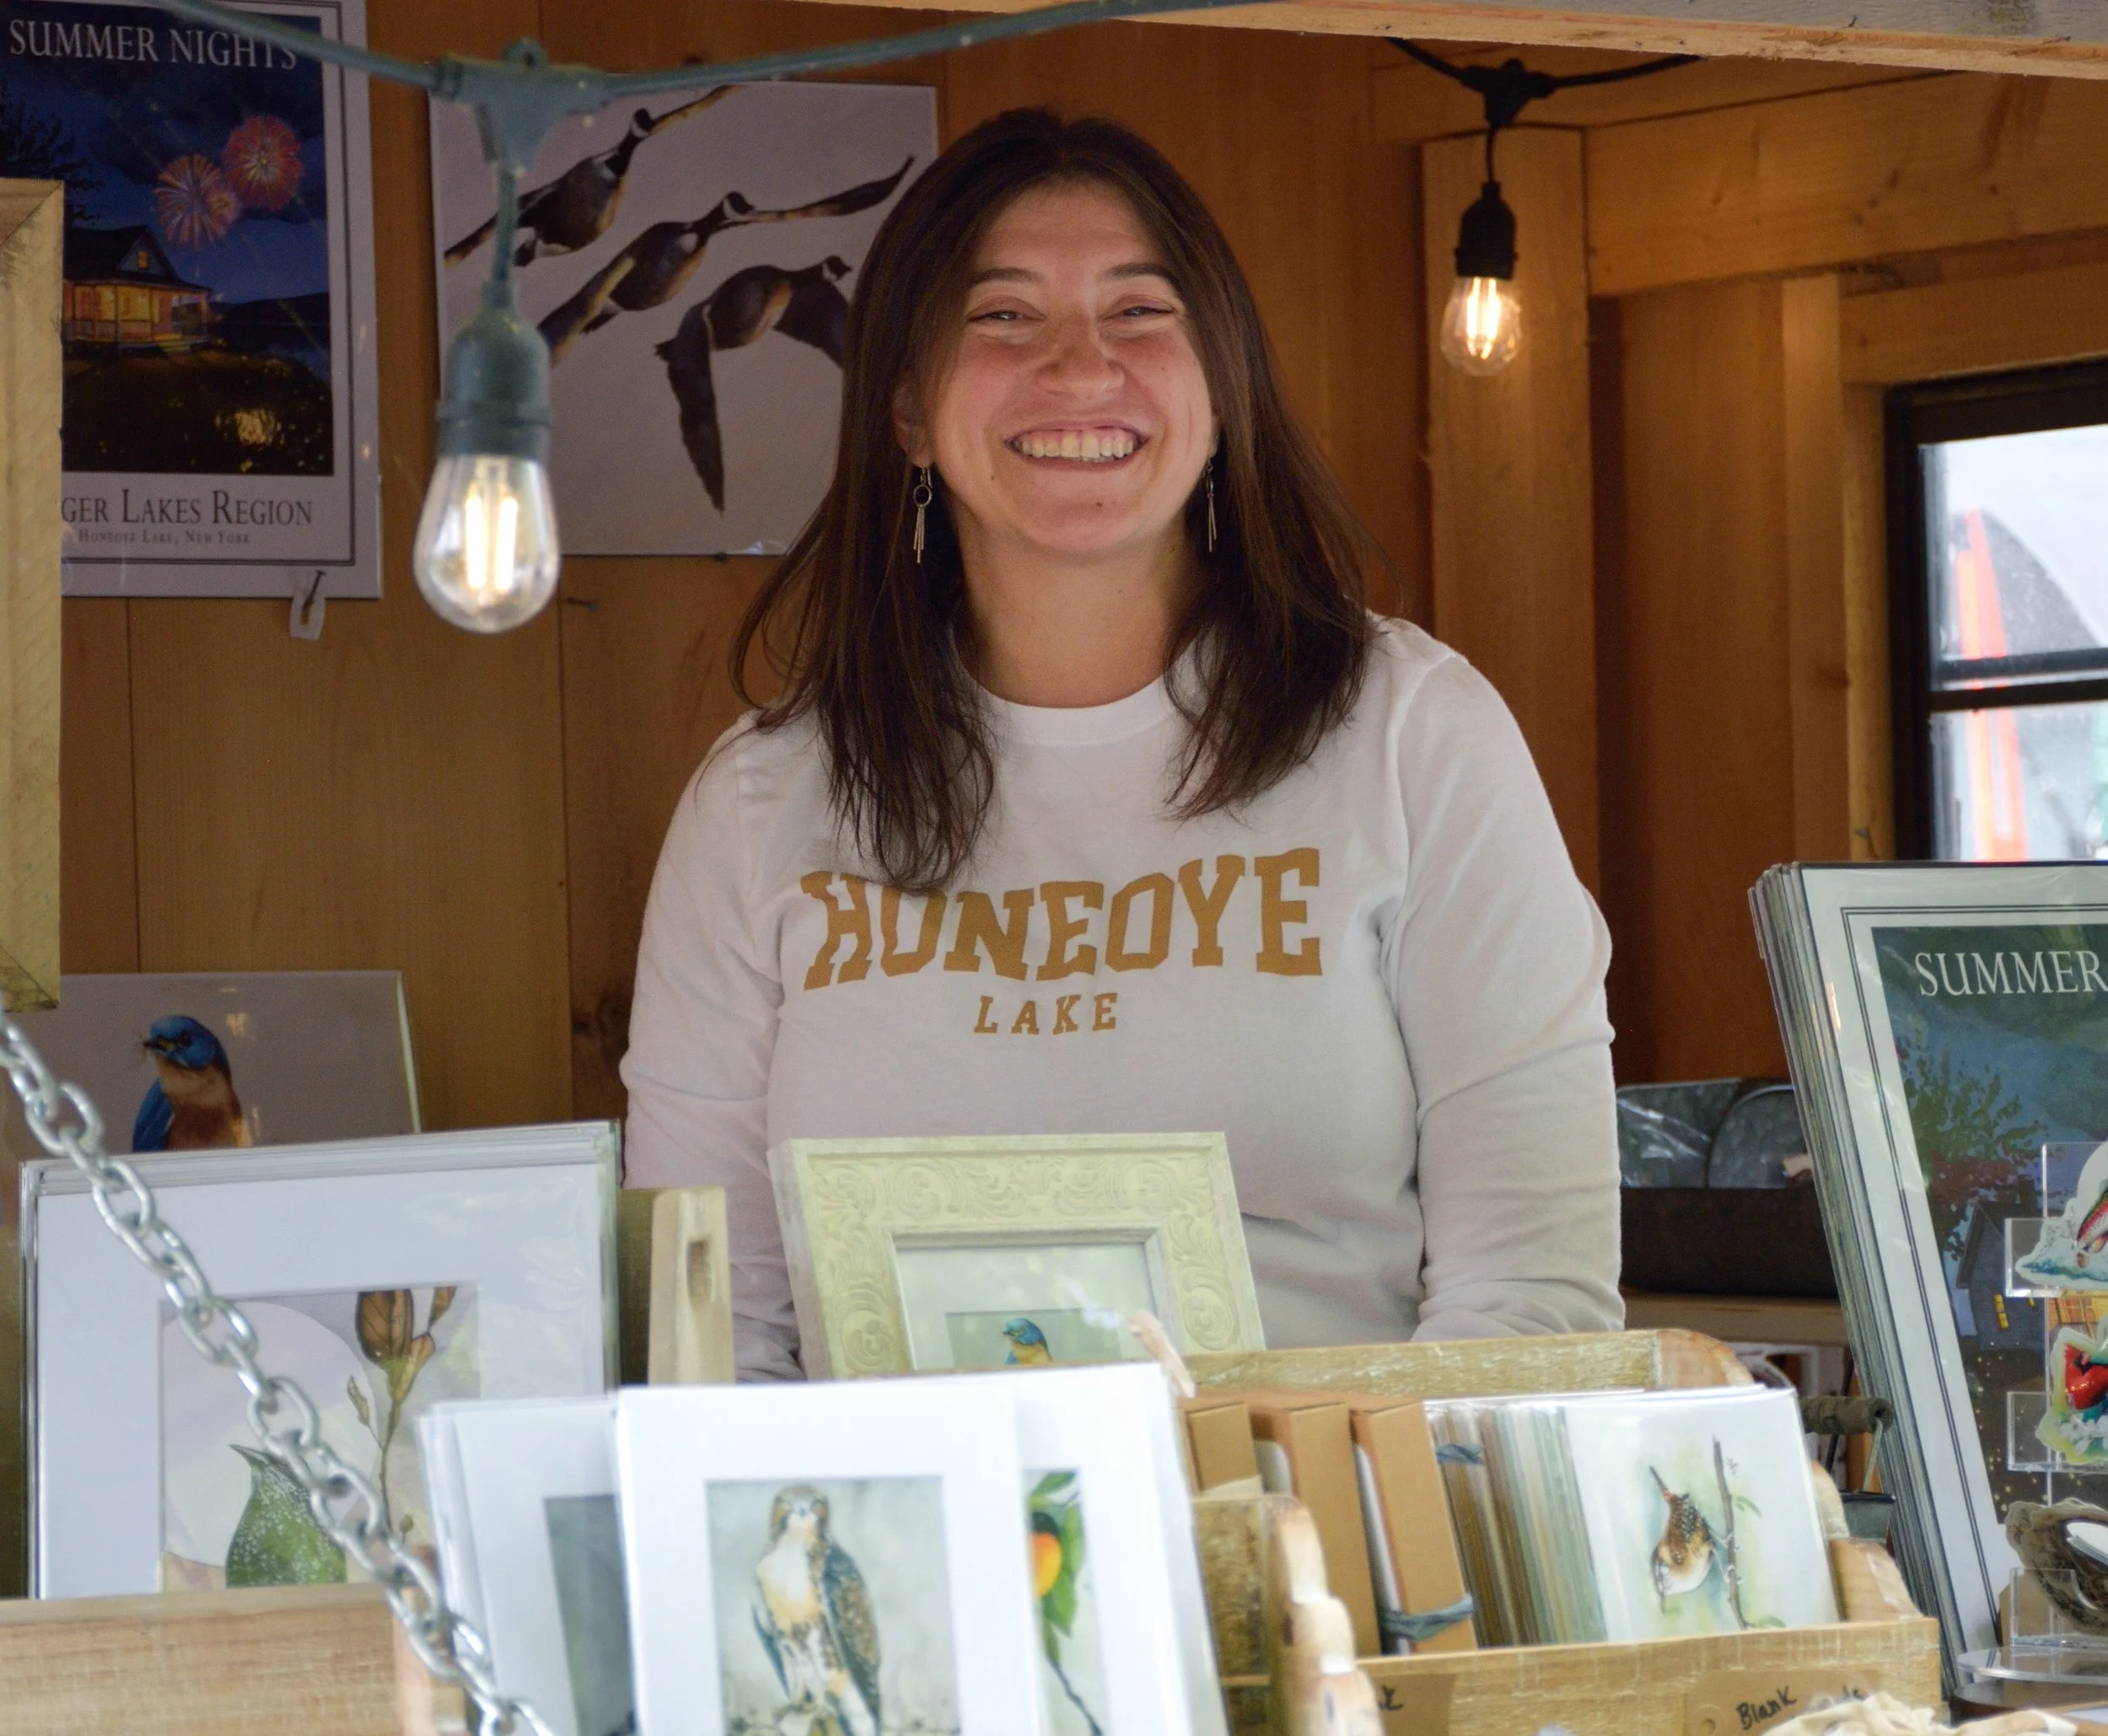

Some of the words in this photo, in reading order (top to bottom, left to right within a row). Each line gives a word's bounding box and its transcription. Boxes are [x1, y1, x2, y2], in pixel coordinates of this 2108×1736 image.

[9, 19, 158, 62] SUMMER
[61, 497, 109, 524] GER
[121, 488, 201, 524] LAKES
[212, 489, 312, 526] REGION
[800, 847, 1323, 991] HONEOYE
[1914, 949, 2108, 997] SUMMER
[974, 992, 1118, 1035] LAKE
[1736, 1685, 1798, 1730] Blank
